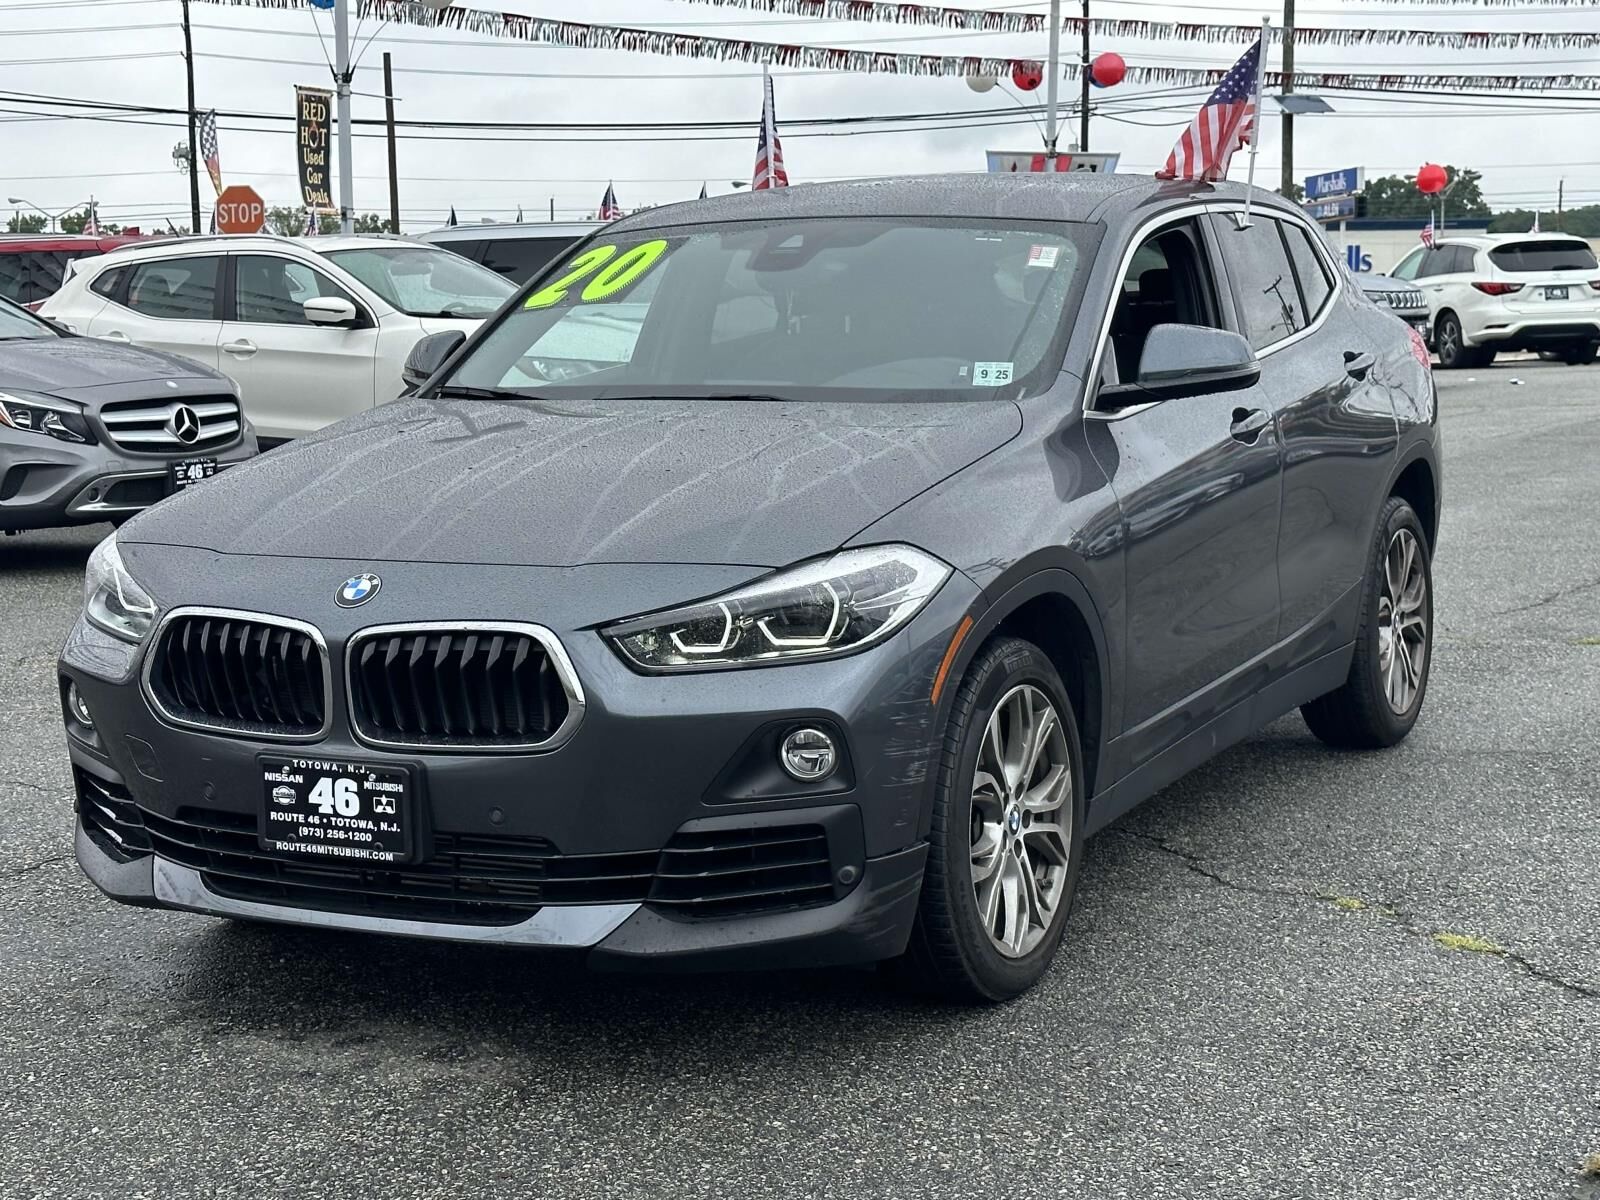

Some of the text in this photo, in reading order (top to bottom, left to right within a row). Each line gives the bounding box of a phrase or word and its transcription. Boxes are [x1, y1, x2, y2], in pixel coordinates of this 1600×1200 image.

[303, 101, 326, 122] RED
[301, 127, 327, 148] HOT
[303, 150, 324, 165] Used
[306, 168, 323, 184] Car
[305, 186, 329, 204] Deals
[219, 203, 261, 223] STOP
[523, 239, 669, 310] 20
[981, 369, 1009, 380] 9 25
[187, 464, 204, 479] 46
[292, 759, 370, 774] TOTOWA, N.J.
[264, 772, 304, 784] NISSAN
[363, 781, 404, 793] MITSUBISHI
[308, 777, 360, 817] 46
[270, 811, 401, 832] ROUTE 46 TOTOWA, N.J.
[298, 826, 373, 842] (973) 256-1200
[275, 841, 394, 862] ROUTE46MITSUBISHI.COM
